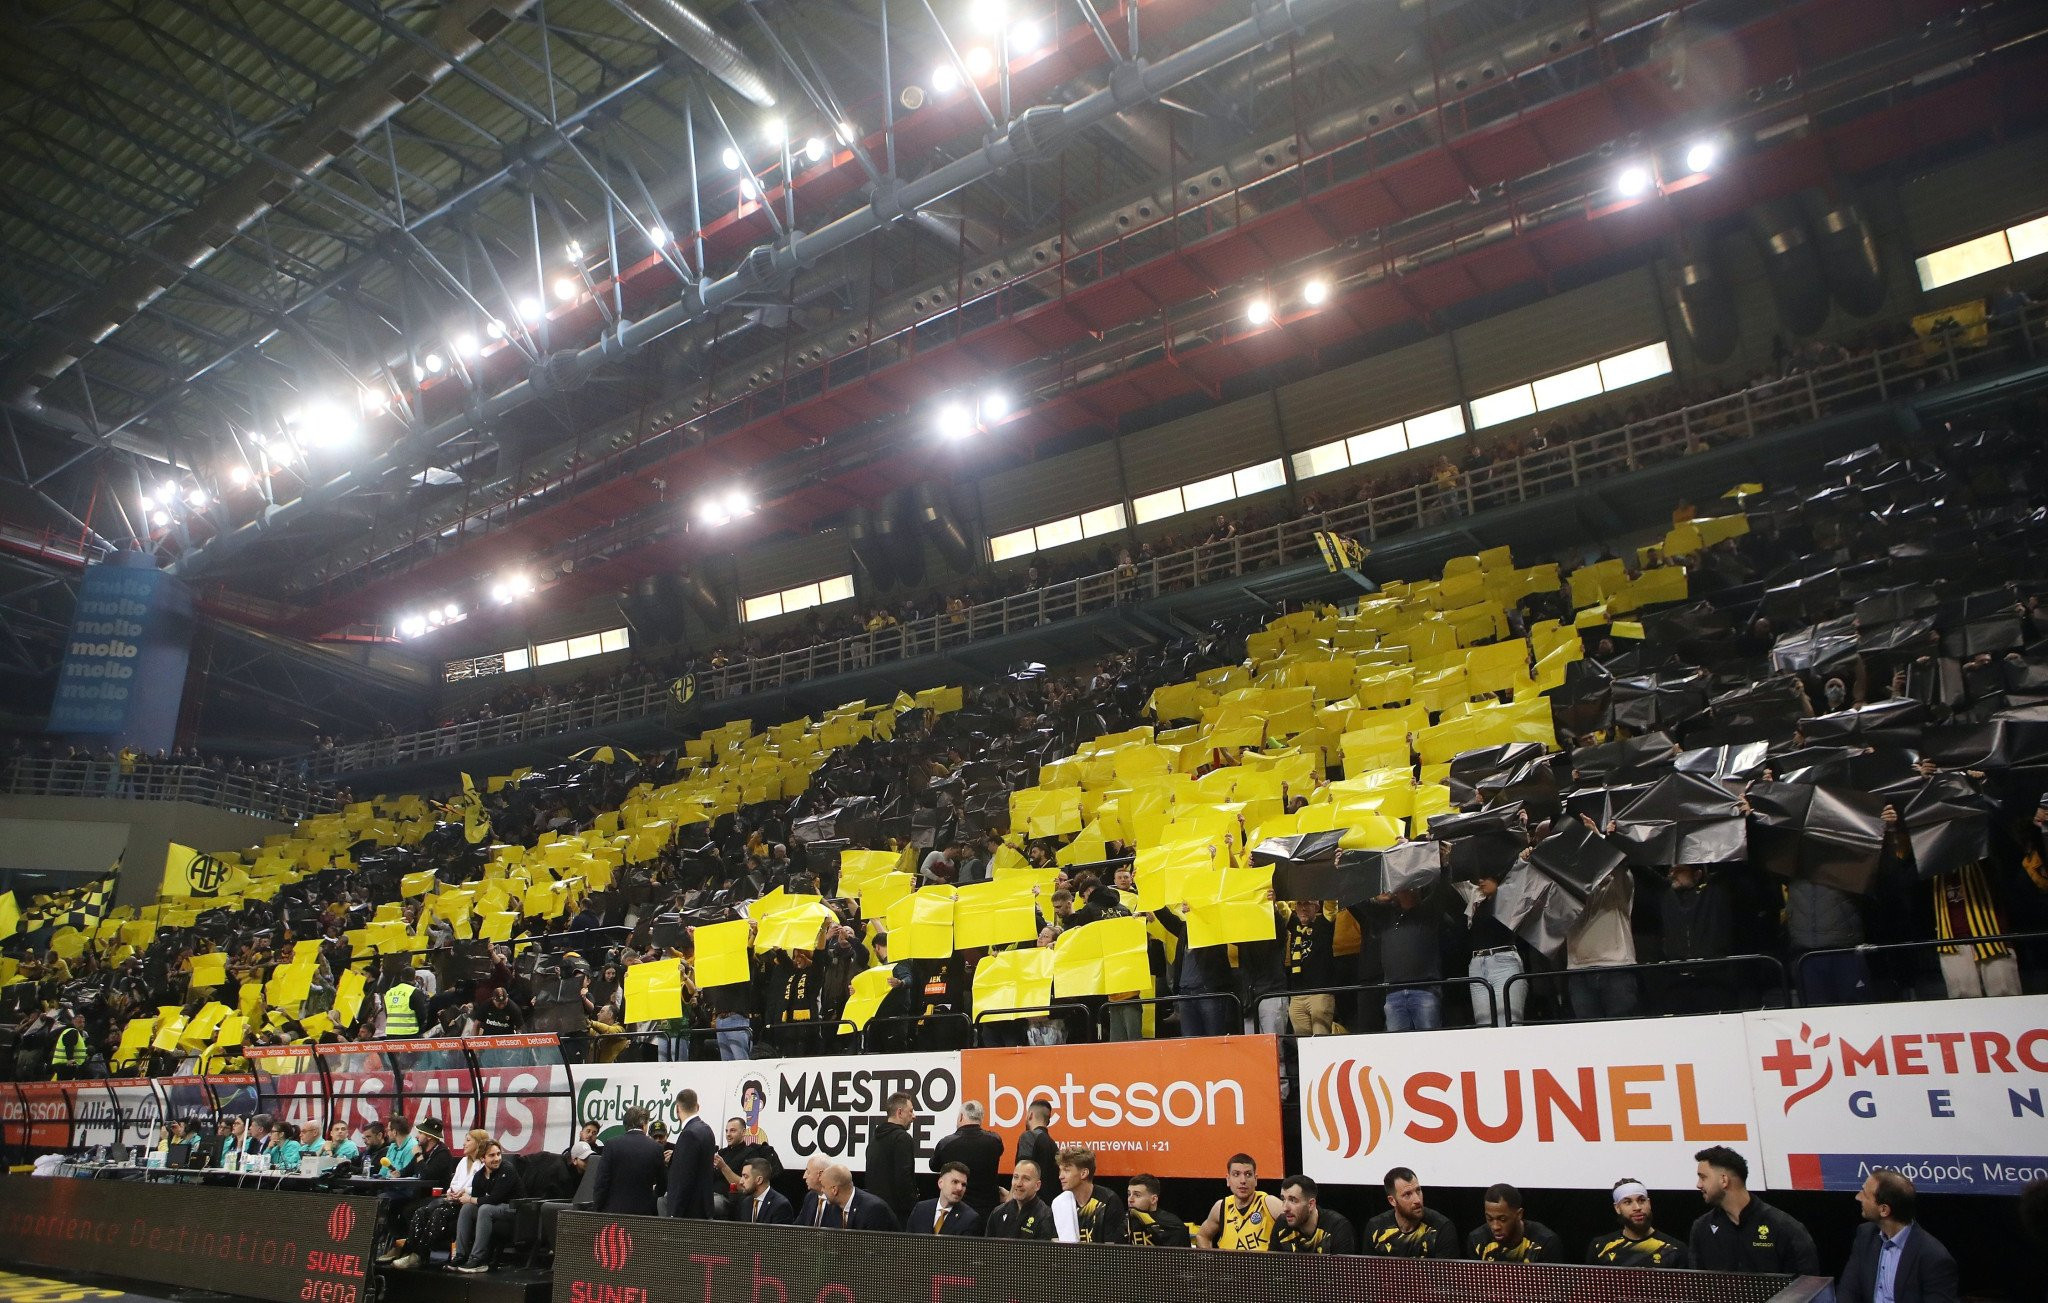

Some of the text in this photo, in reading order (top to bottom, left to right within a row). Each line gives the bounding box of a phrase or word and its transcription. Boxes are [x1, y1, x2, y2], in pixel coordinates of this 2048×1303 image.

[71, 640, 138, 658] molto
[778, 1067, 956, 1112] MAESTRO
[988, 1073, 1245, 1128] betsson
[3, 1100, 67, 1120] besson
[411, 1073, 539, 1151] AVIS
[1403, 1064, 1748, 1143] SUNEL
[791, 1114, 935, 1158] COFE
[1085, 1141, 1143, 1151] ΥΠΕΥΘΥΝΑ
[1152, 1141, 1170, 1151] +21
[1132, 1231, 1155, 1246] EK
[1236, 1228, 1268, 1250] AEK
[306, 1250, 365, 1277] SUNEL
[300, 1278, 357, 1303] arena
